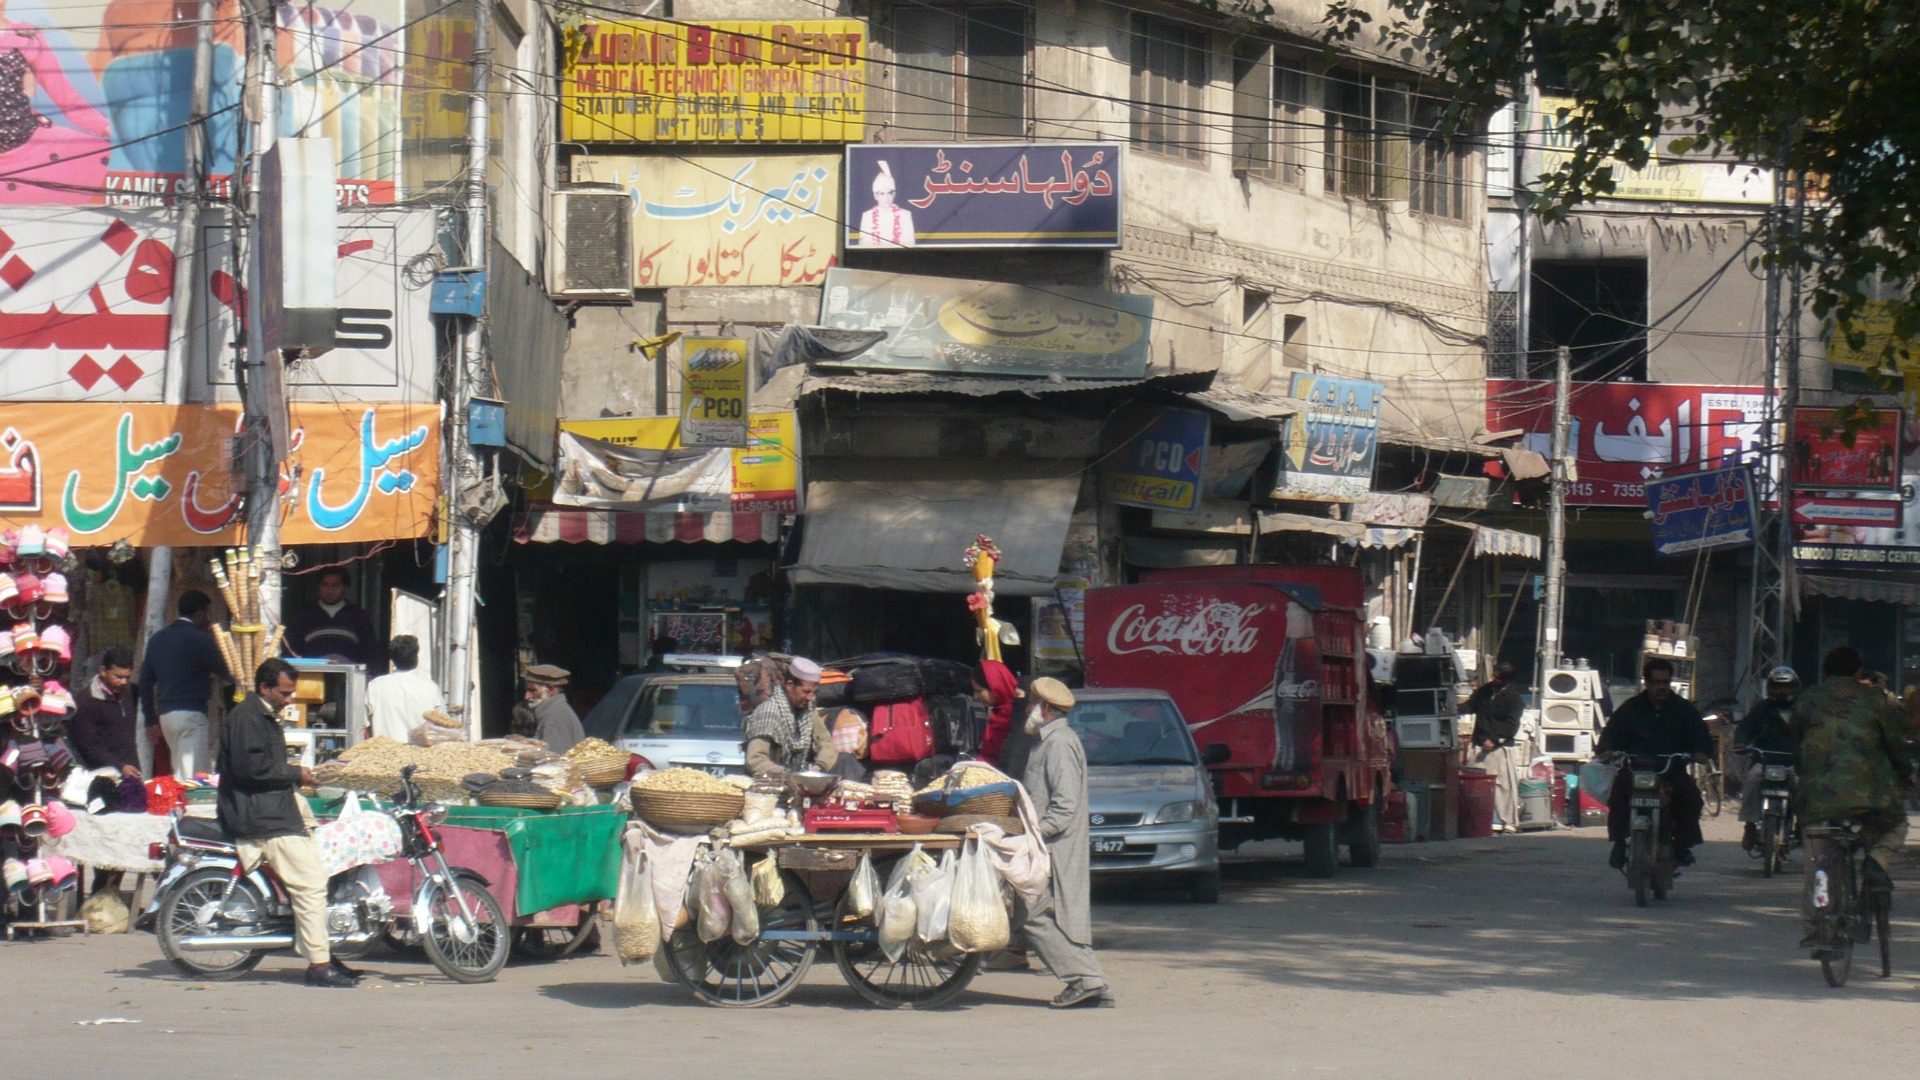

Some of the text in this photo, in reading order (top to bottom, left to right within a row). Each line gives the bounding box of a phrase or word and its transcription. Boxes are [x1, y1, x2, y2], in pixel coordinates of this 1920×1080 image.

[577, 24, 677, 65] ZUBAIR
[772, 24, 861, 66] DEPOT
[758, 96, 786, 115] AND
[794, 96, 861, 116] MEDICAL
[105, 176, 168, 207] KAMIZ
[703, 397, 742, 418] PCO
[306, 407, 430, 533] سیل
[1139, 438, 1184, 474] PCO
